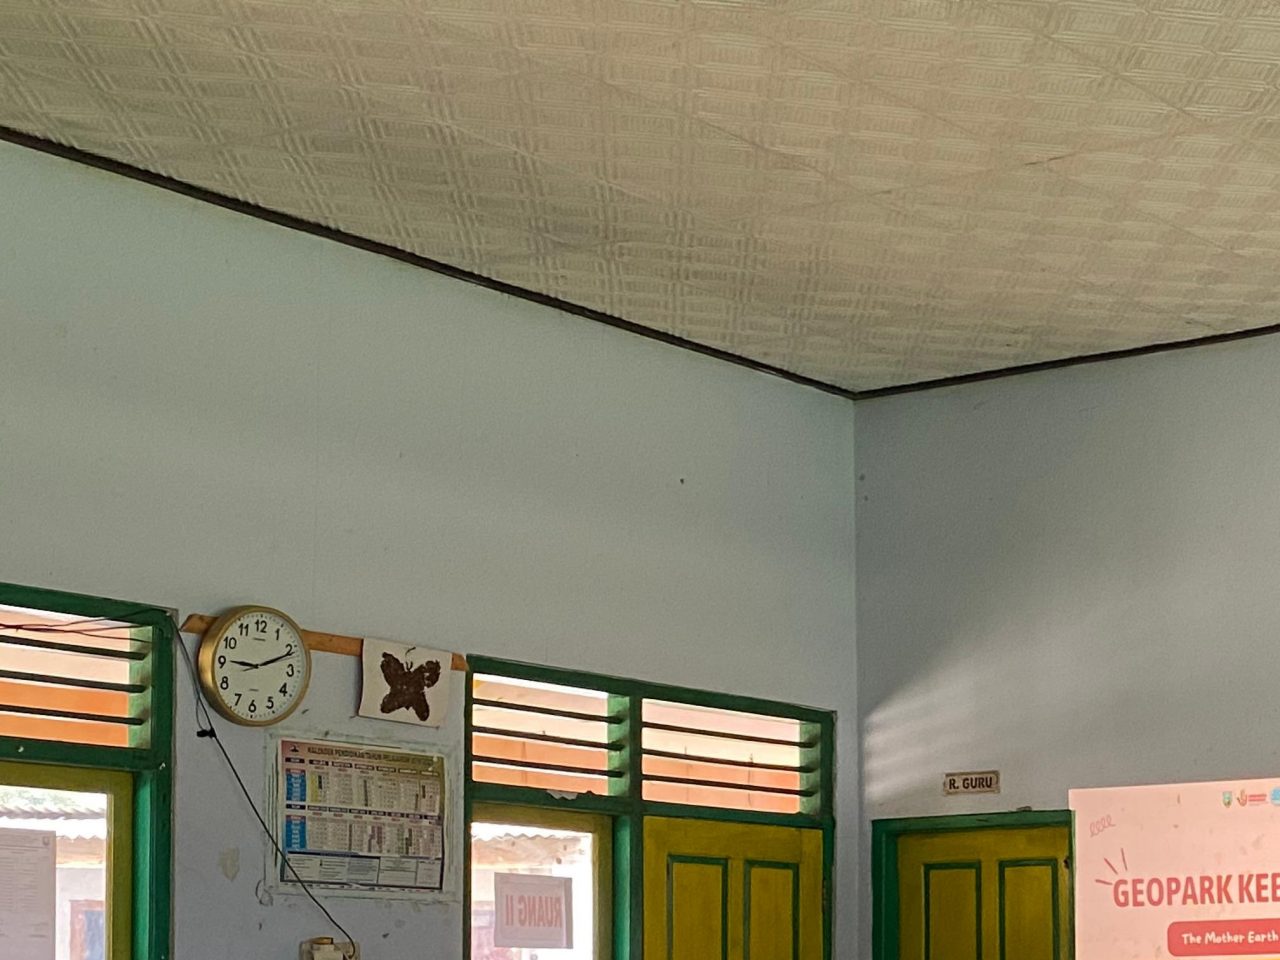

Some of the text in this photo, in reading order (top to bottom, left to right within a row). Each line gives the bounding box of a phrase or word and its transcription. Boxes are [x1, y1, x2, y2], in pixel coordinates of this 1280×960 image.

[238, 623, 249, 637] 11
[255, 619, 267, 633] 12
[275, 628, 280, 640] 1
[223, 636, 237, 649] 10
[285, 643, 293, 656] 2
[218, 655, 226, 669] 9
[286, 664, 294, 677] 3
[220, 676, 229, 690] 8
[279, 682, 288, 697] 4
[234, 693, 242, 706] 7
[248, 700, 257, 713] 6
[266, 696, 274, 709] 5
[949, 776, 992, 790] R. GURU
[1113, 874, 1233, 908] GEOPARK
[1182, 932, 1201, 944] The
[1204, 931, 1245, 944] Mother
[1247, 929, 1279, 943] Earth
